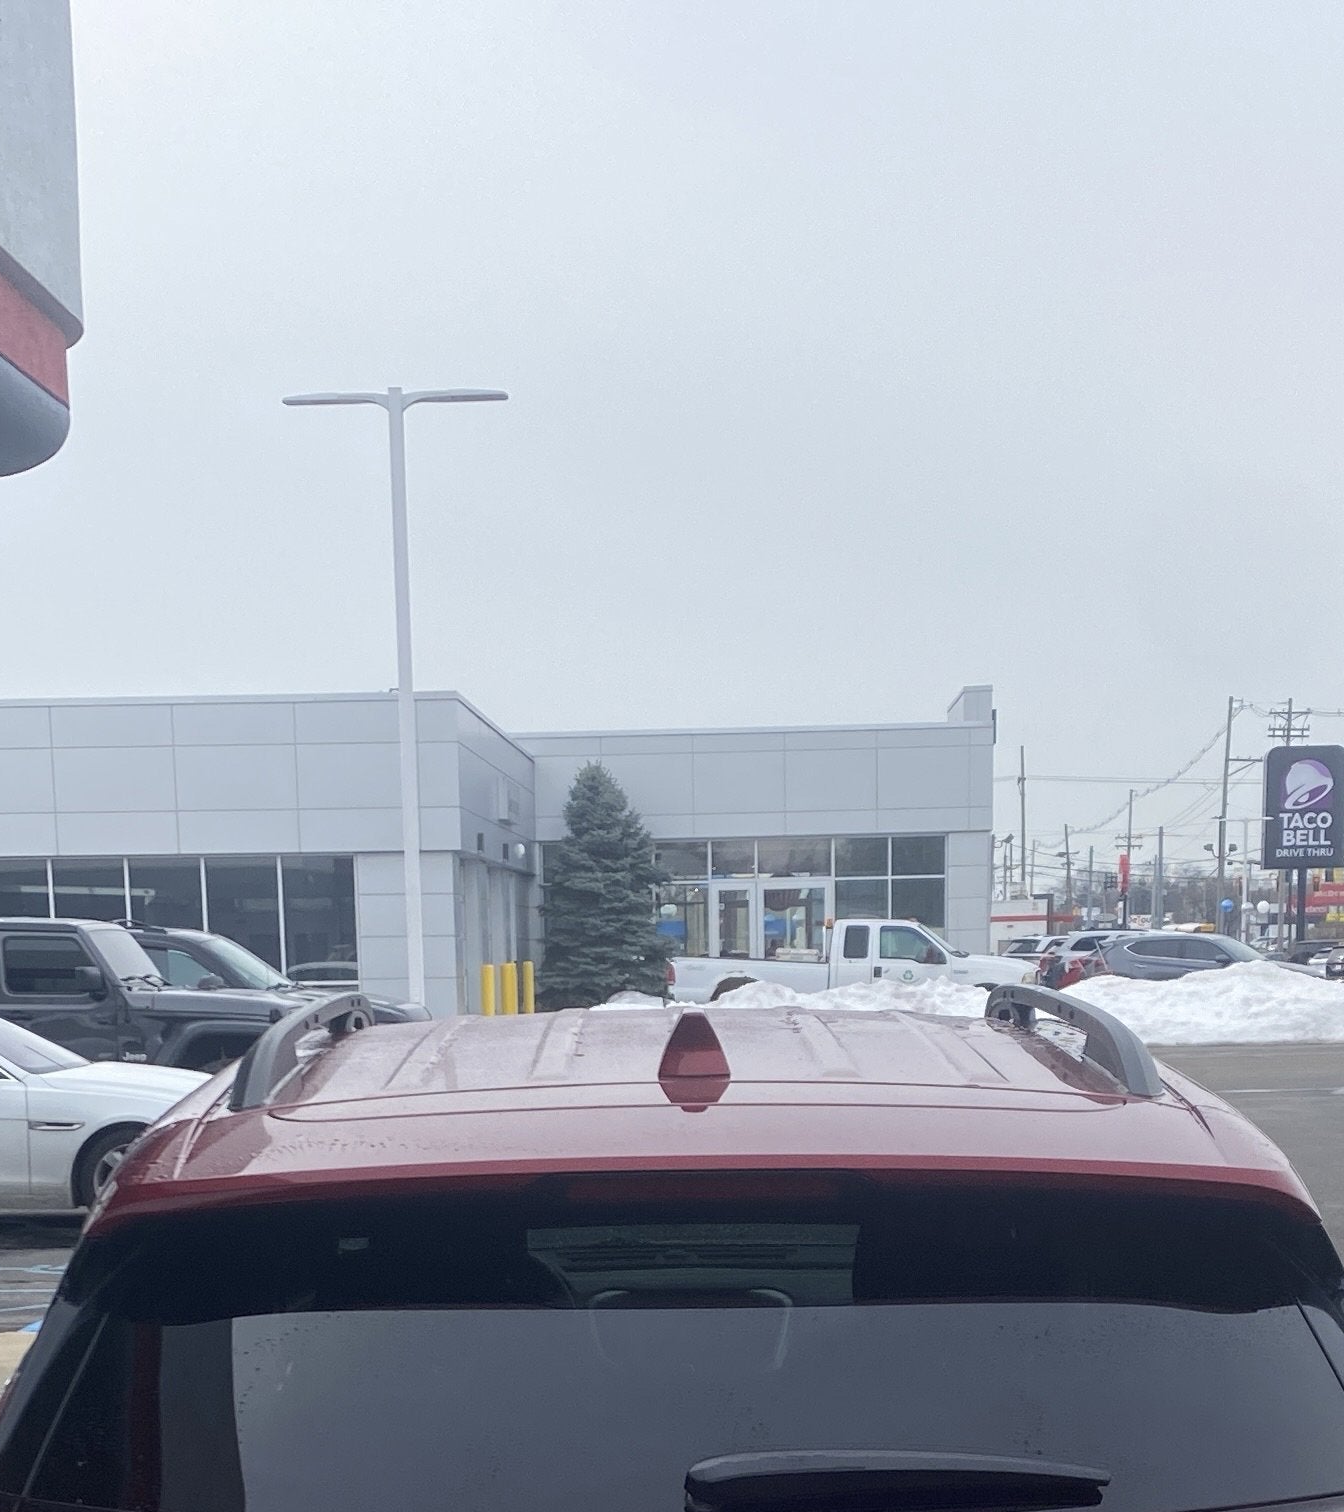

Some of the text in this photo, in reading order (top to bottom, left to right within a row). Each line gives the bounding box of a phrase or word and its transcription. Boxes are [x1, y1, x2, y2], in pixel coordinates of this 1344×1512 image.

[1279, 811, 1333, 829] TACO
[1282, 829, 1332, 846] BELL
[1276, 847, 1334, 858] DRIVE THRU
